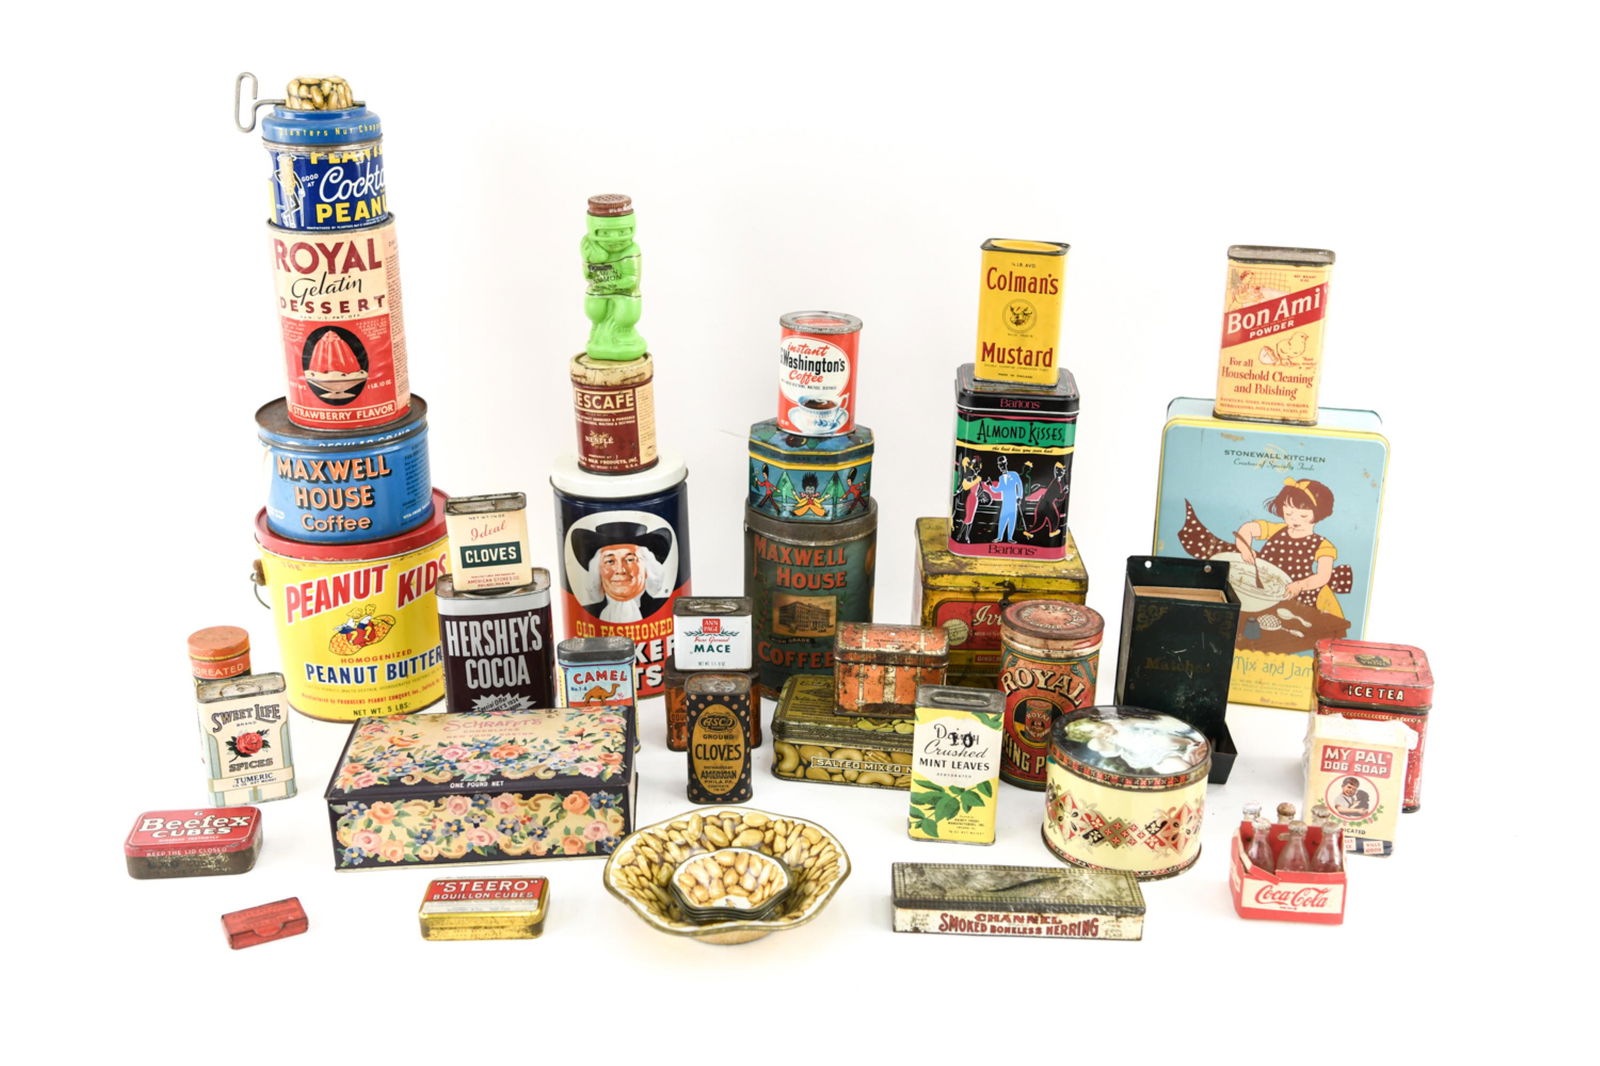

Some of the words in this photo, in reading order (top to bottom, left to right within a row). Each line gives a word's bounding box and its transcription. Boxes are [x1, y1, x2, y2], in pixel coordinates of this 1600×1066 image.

[301, 173, 319, 182] GOOD
[273, 238, 382, 275] ROYAL
[291, 271, 362, 305] Gelatin
[986, 266, 1059, 295] Colman's
[280, 294, 385, 314] DESSERT
[1227, 307, 1270, 334] Bon
[1273, 288, 1321, 321] Ami
[1249, 320, 1295, 339] POWDER
[784, 349, 846, 376] Washington's
[981, 341, 1053, 368] Mustard
[1229, 357, 1241, 366] For
[1243, 359, 1254, 367] all
[789, 369, 824, 385] Coffee
[1222, 366, 1269, 381] Household
[1271, 371, 1314, 388] Cleaning
[1234, 383, 1252, 394] and
[1254, 383, 1298, 401] Polishing
[293, 406, 352, 421] STRAWBERRY
[356, 403, 394, 419] FLAVOR
[1000, 399, 1040, 409] Bartons
[977, 419, 1026, 444] ALMOND
[1224, 449, 1281, 460] STONEWALL
[1283, 455, 1326, 463] KITCHEN
[276, 455, 392, 482] MAXWELL
[294, 484, 375, 511] HOUSE
[301, 513, 372, 532] Coffee
[465, 546, 517, 563] CLOVES
[754, 534, 847, 567] MAXWELL
[988, 545, 1036, 555] Bartons
[777, 567, 847, 589] HOUSE
[286, 564, 390, 624] PEANUT
[397, 553, 447, 608] KIDS
[445, 611, 543, 657] HERSHEY'S
[576, 620, 596, 638] OLD
[600, 617, 673, 641] FASHIONED
[340, 648, 412, 664] HOMOGENIZED
[694, 645, 731, 653] MACE
[757, 641, 834, 668] COFFEE
[306, 663, 378, 684] PEANUT
[386, 645, 443, 682] BUTTER
[465, 655, 531, 690] COCOA
[1233, 655, 1256, 675] Mix
[1262, 661, 1285, 676] and
[573, 670, 627, 685] CAMEL
[1000, 667, 1086, 708] ROYAL
[1347, 685, 1373, 697] ICE
[1378, 688, 1404, 700] TEA
[211, 707, 254, 733] SWEET
[254, 703, 281, 724] LIFE
[353, 706, 367, 716] NET
[387, 704, 392, 712] 5
[695, 743, 742, 761] CLOVES
[924, 738, 989, 759] Crushed
[1325, 748, 1352, 760] MY
[1355, 751, 1388, 765] PAL
[228, 757, 274, 773] SPICES
[816, 759, 859, 769] SALTED
[866, 763, 902, 773] MIXED
[919, 757, 946, 769] MINT
[951, 760, 990, 771] LEAVES
[1324, 761, 1349, 771] DOG
[1354, 763, 1388, 775] SOAP
[234, 772, 274, 785] TUMERIC
[139, 815, 251, 832] Beefex
[152, 827, 232, 839] CUBES
[432, 892, 490, 900] BOUILLON
[1255, 884, 1331, 908] Coca-Cola
[938, 912, 988, 934] SMOKED
[990, 925, 1042, 935] BONELESS
[1048, 917, 1099, 937] HERRING
[974, 913, 1062, 925] CHANNEL
